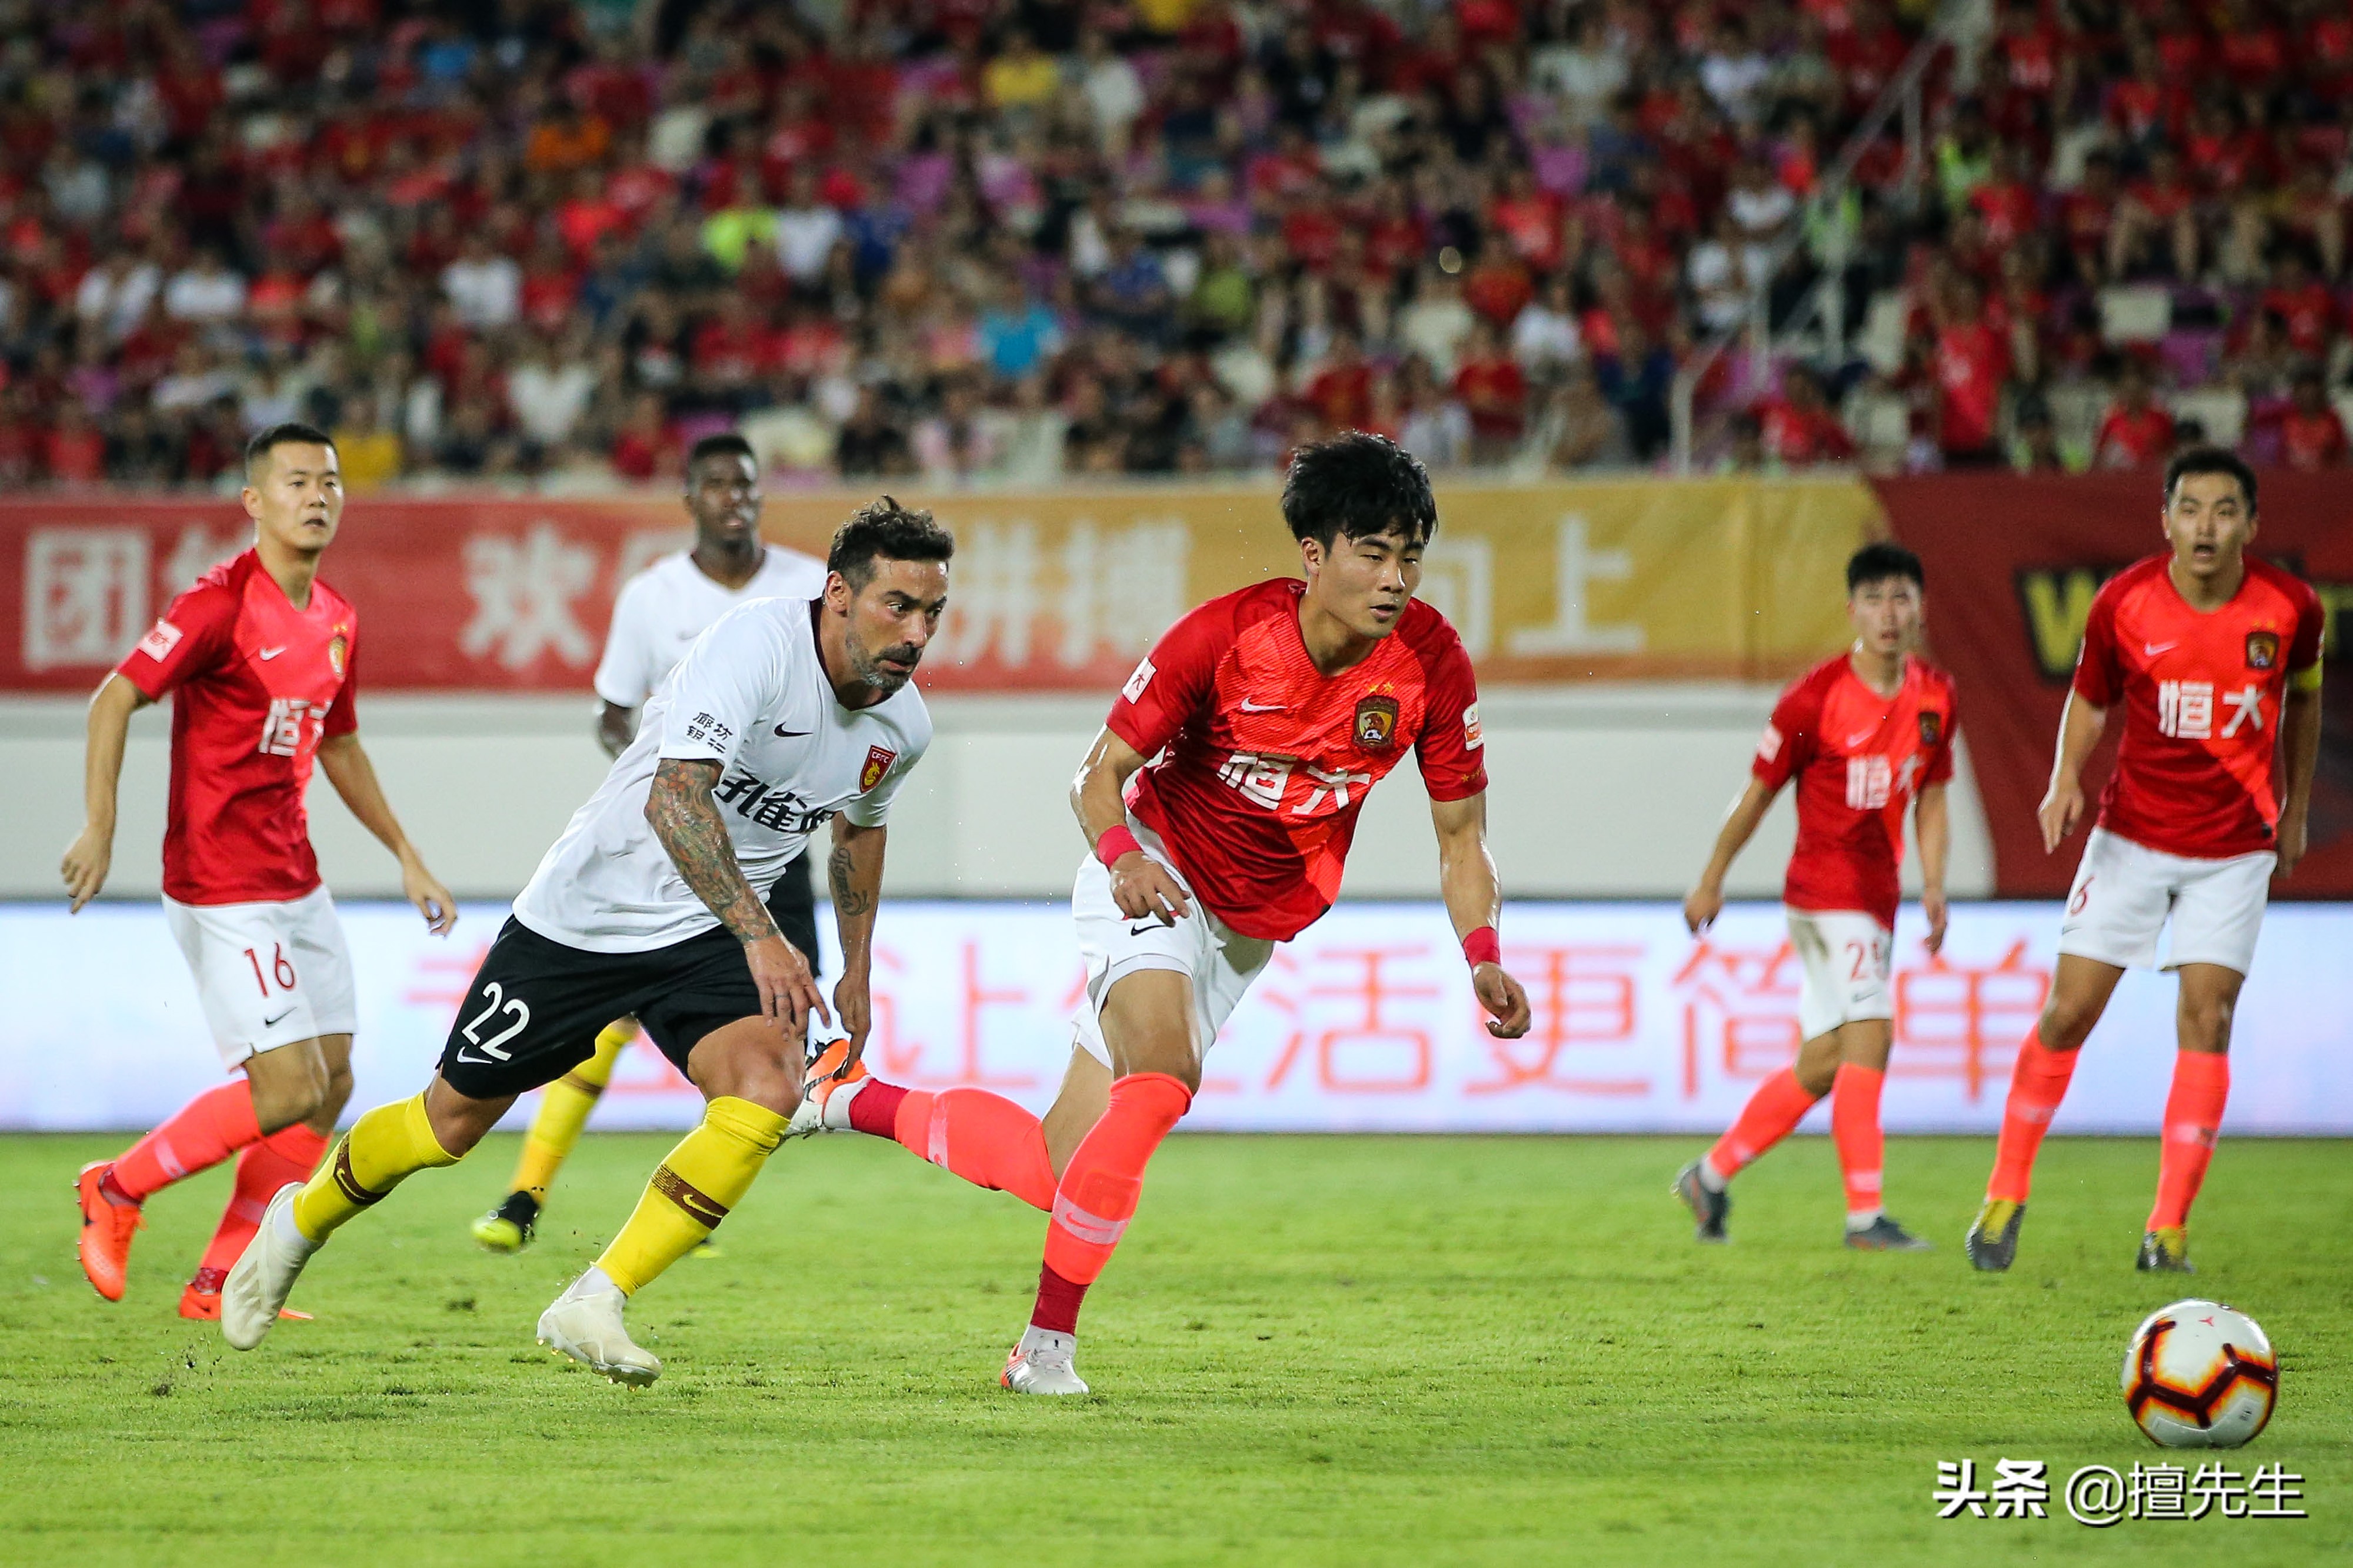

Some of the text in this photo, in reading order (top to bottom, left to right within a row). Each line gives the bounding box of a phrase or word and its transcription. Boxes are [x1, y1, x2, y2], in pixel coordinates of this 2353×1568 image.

[692, 711, 734, 740] 廊坊
[2158, 680, 2267, 740] 恒大
[686, 725, 726, 754] 银行
[1216, 750, 1372, 815] 恒大
[2070, 873, 2096, 917] 6
[244, 942, 295, 999] 16
[405, 934, 2053, 1106] 让活更简单
[461, 981, 530, 1062] 22
